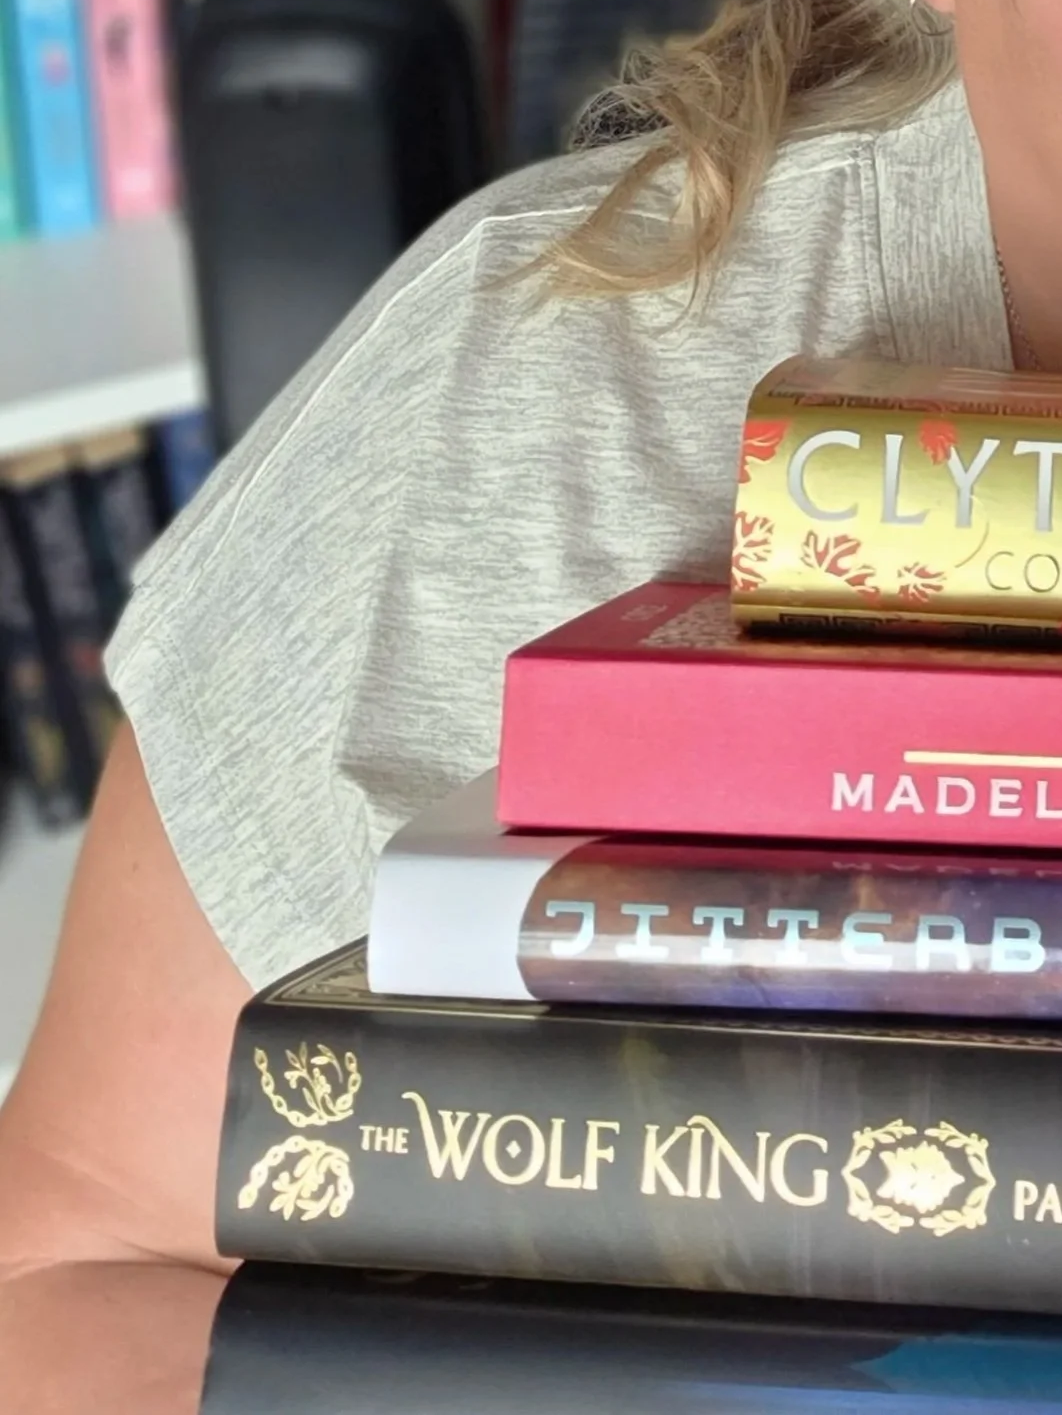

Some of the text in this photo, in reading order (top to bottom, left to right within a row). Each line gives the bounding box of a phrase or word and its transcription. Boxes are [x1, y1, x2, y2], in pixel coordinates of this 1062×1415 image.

[359, 1090, 830, 1208] THE WOLF KING
